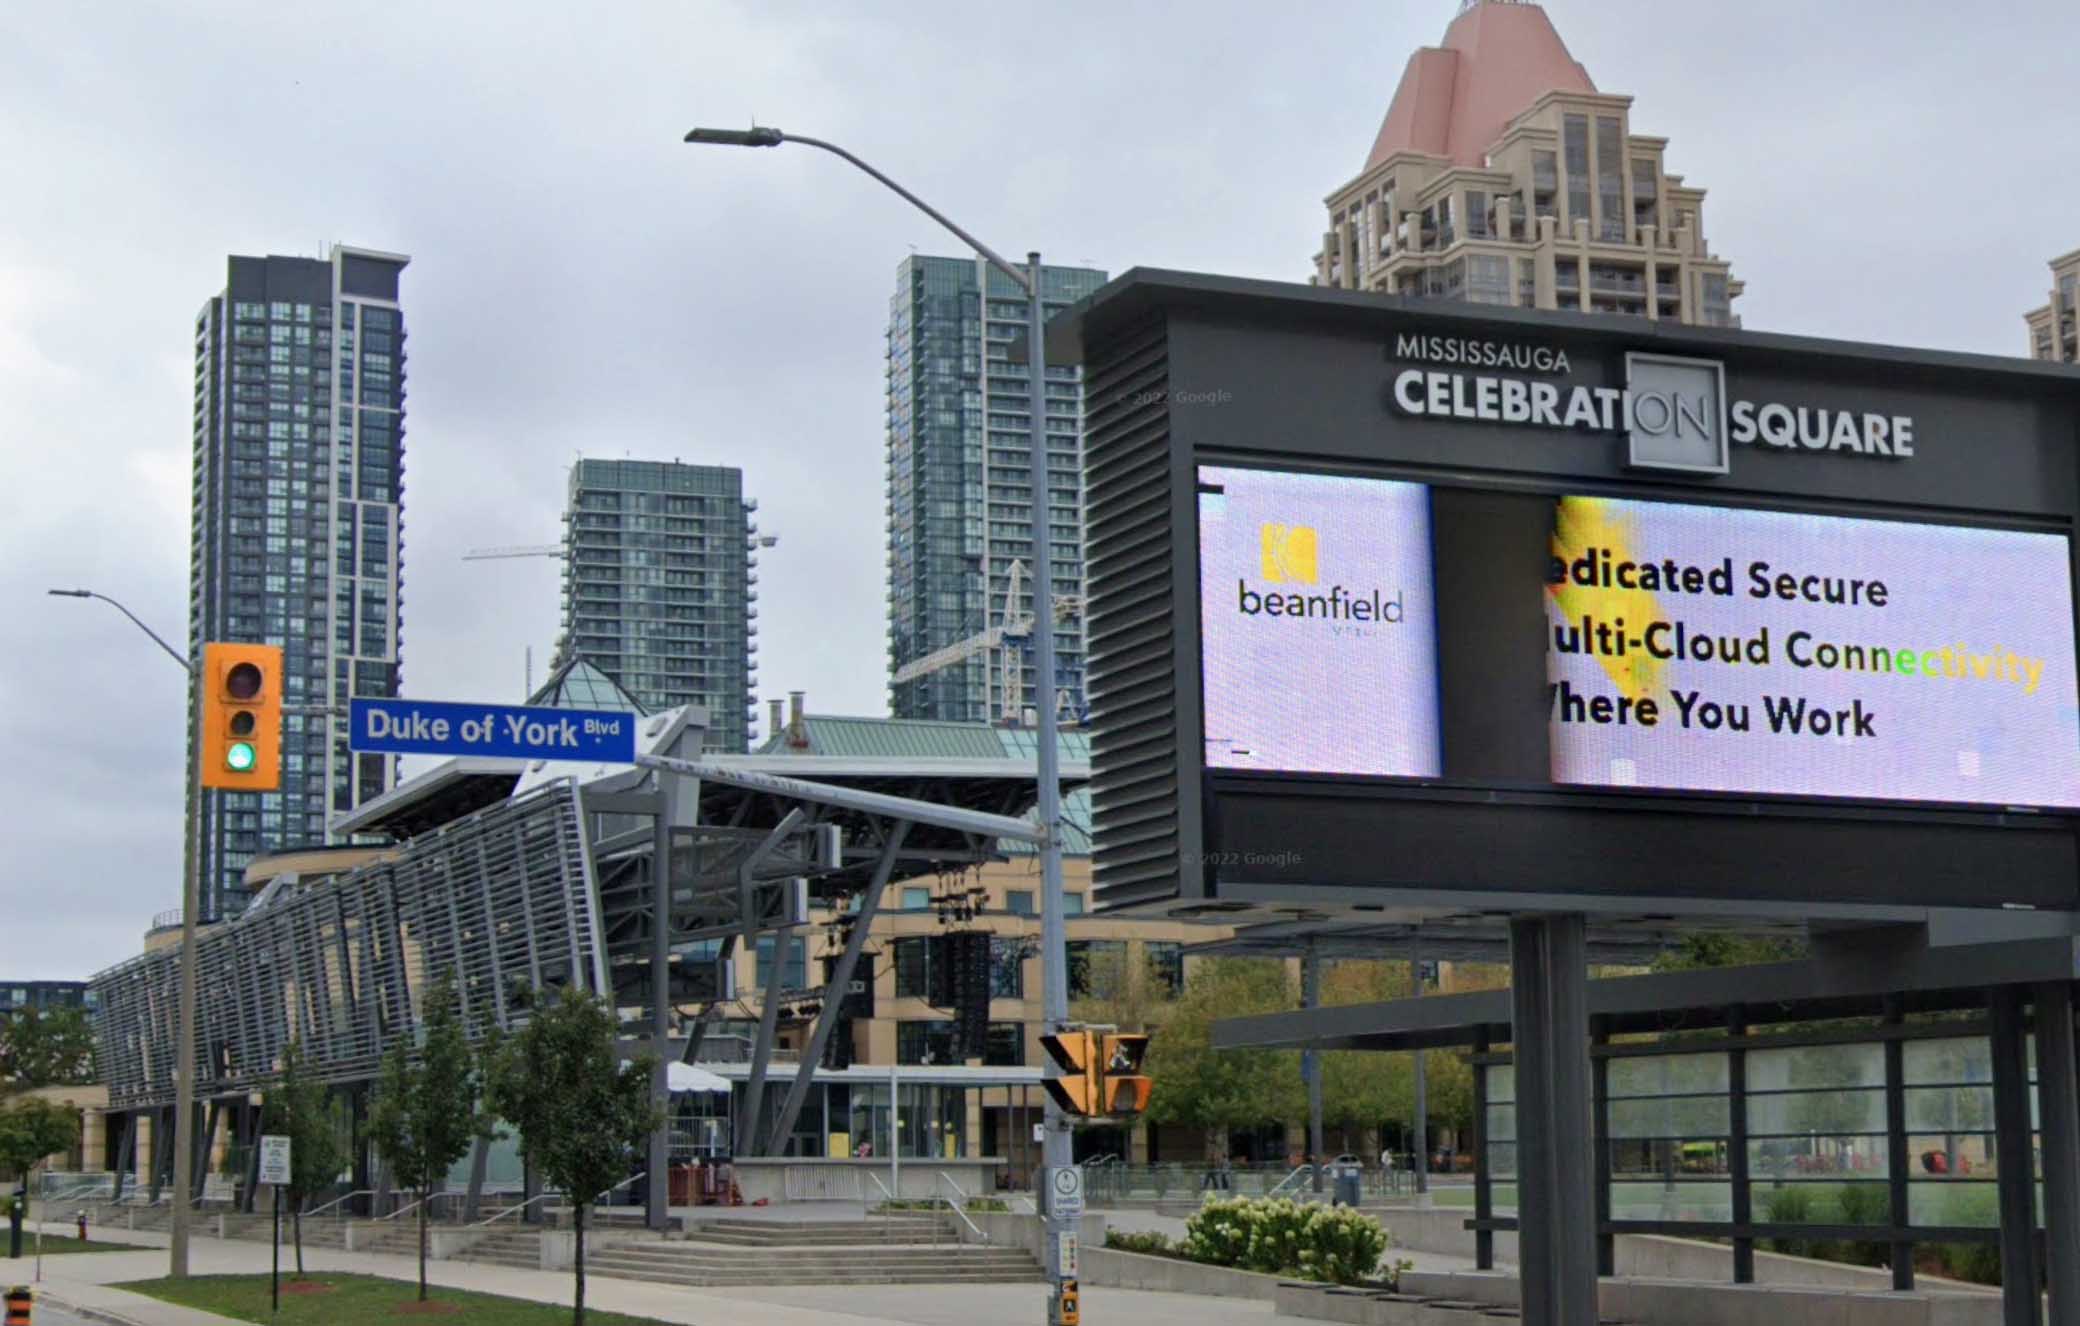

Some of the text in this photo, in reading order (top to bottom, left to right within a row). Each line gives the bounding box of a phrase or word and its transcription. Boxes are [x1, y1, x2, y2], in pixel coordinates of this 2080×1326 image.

[1396, 333, 1571, 373] MISSISSAUGA
[1731, 400, 1914, 456] SQUARE
[1238, 578, 1403, 623] beanfield
[1748, 561, 1888, 607] Secure
[1546, 615, 2044, 695] ulti-Cloud Connectivity
[366, 708, 620, 747] Duke of York Blvd
[1549, 681, 1876, 737] here You Work
